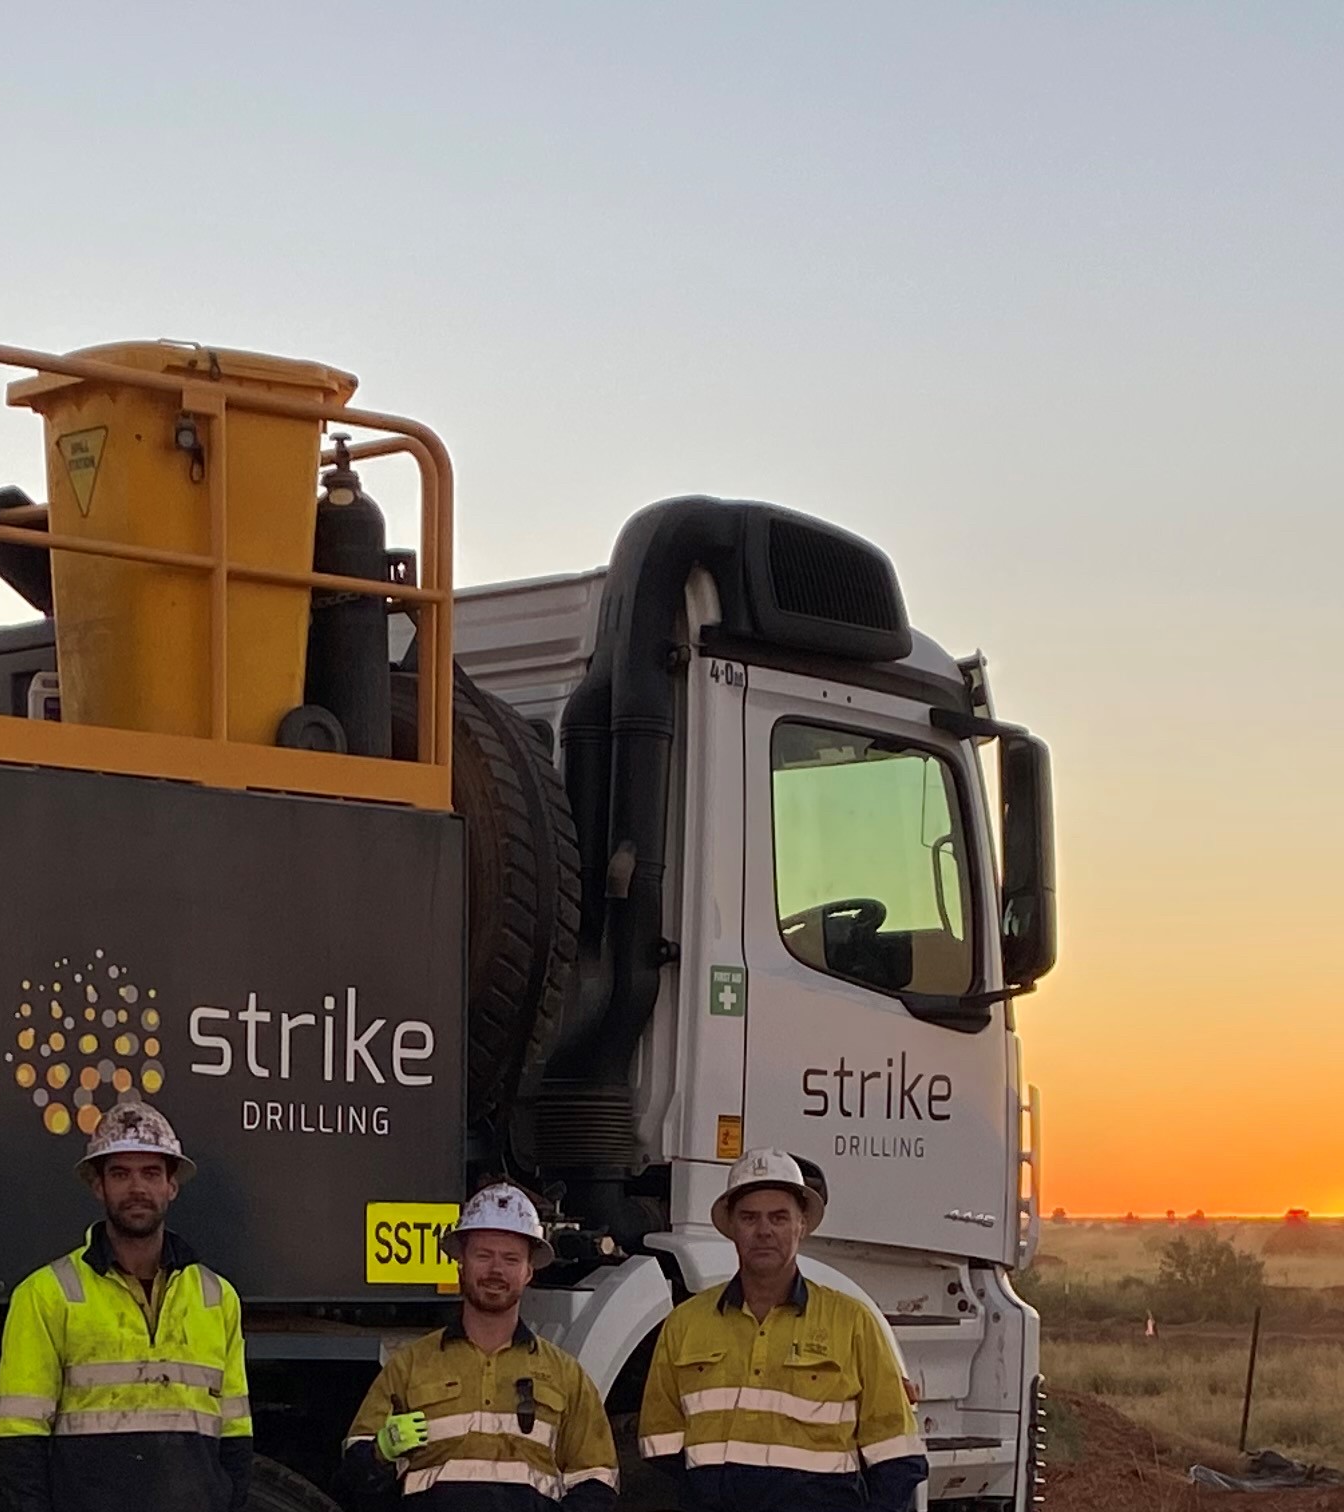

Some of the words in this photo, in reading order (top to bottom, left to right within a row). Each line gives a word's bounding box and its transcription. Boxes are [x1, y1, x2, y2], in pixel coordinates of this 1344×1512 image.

[189, 986, 435, 1087] strike
[803, 1051, 952, 1122] strike
[242, 1100, 390, 1136] DRILLING
[834, 1135, 925, 1158] DRILLING
